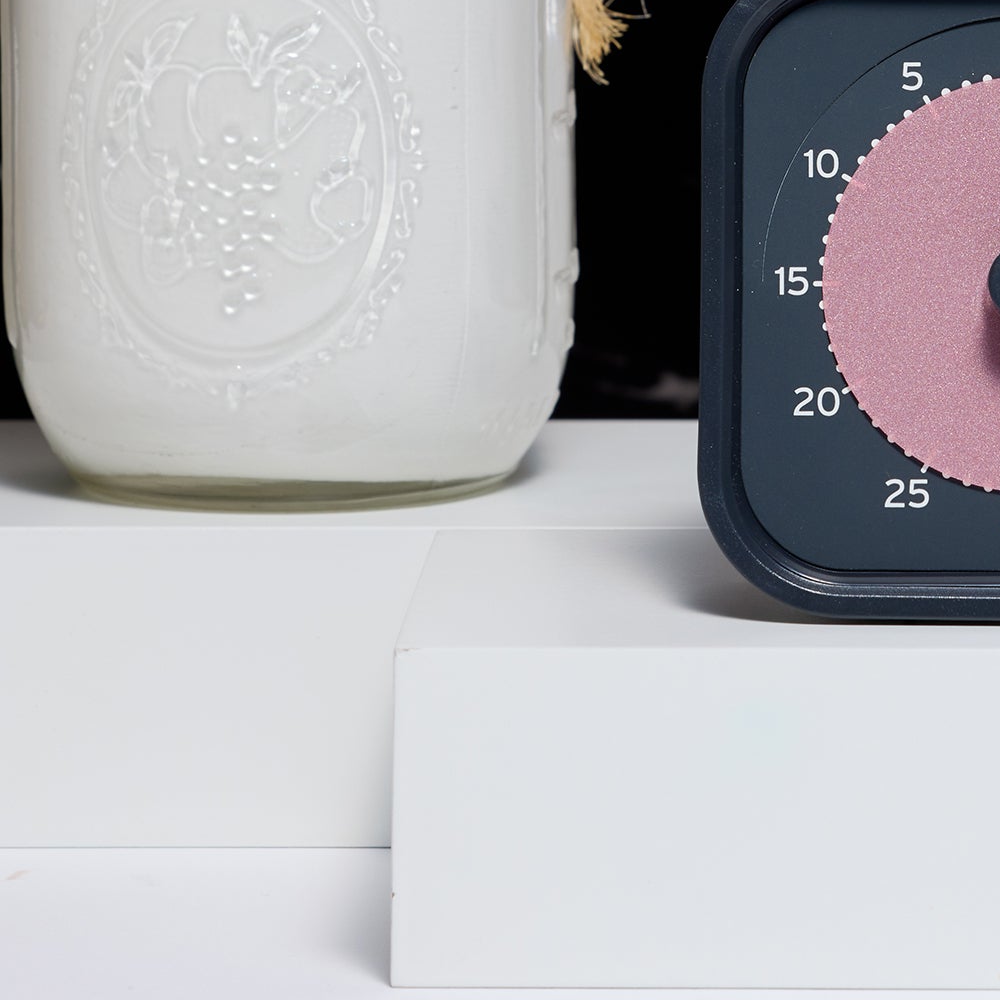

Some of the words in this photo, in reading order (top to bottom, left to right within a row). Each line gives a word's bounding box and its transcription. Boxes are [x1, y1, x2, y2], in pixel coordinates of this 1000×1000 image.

[901, 61, 924, 92] 5
[803, 148, 840, 179] 10
[774, 266, 809, 296] 15
[793, 386, 841, 417] 20
[884, 478, 930, 509] 25
